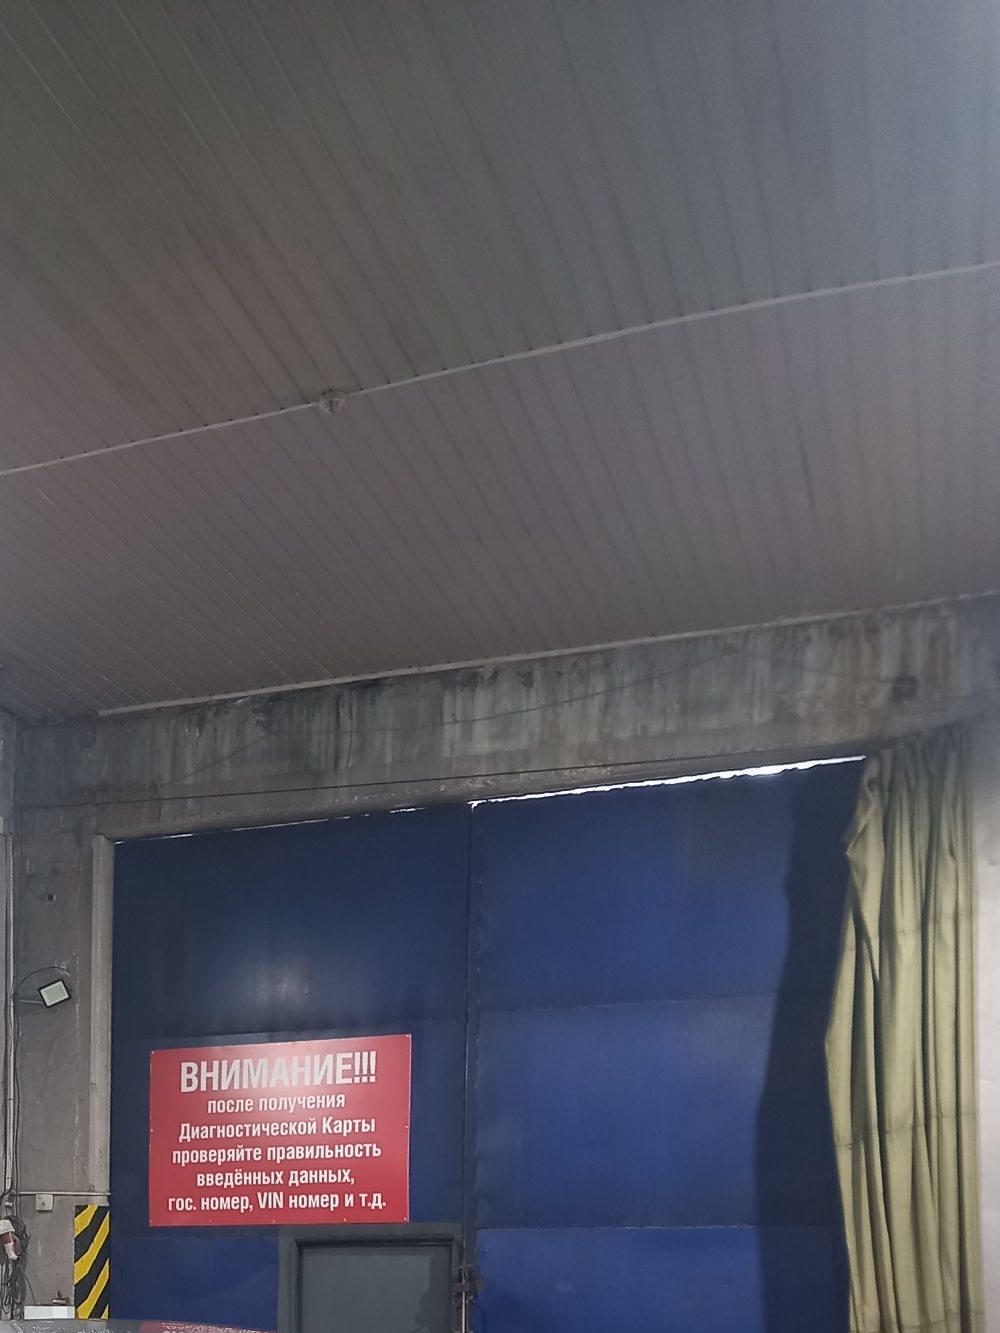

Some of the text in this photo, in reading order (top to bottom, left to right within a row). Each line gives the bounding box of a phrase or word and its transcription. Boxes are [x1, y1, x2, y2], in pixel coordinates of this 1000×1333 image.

[180, 1051, 376, 1093] ВНИМАНИЕ!!!
[207, 1093, 346, 1114] после получения
[179, 1117, 376, 1142] Диагностической Карты
[172, 1143, 382, 1166] проверяйте правильность
[196, 1168, 355, 1188] введённых данных,
[168, 1191, 387, 1213] гос. номер, VIN номер и т.д.
